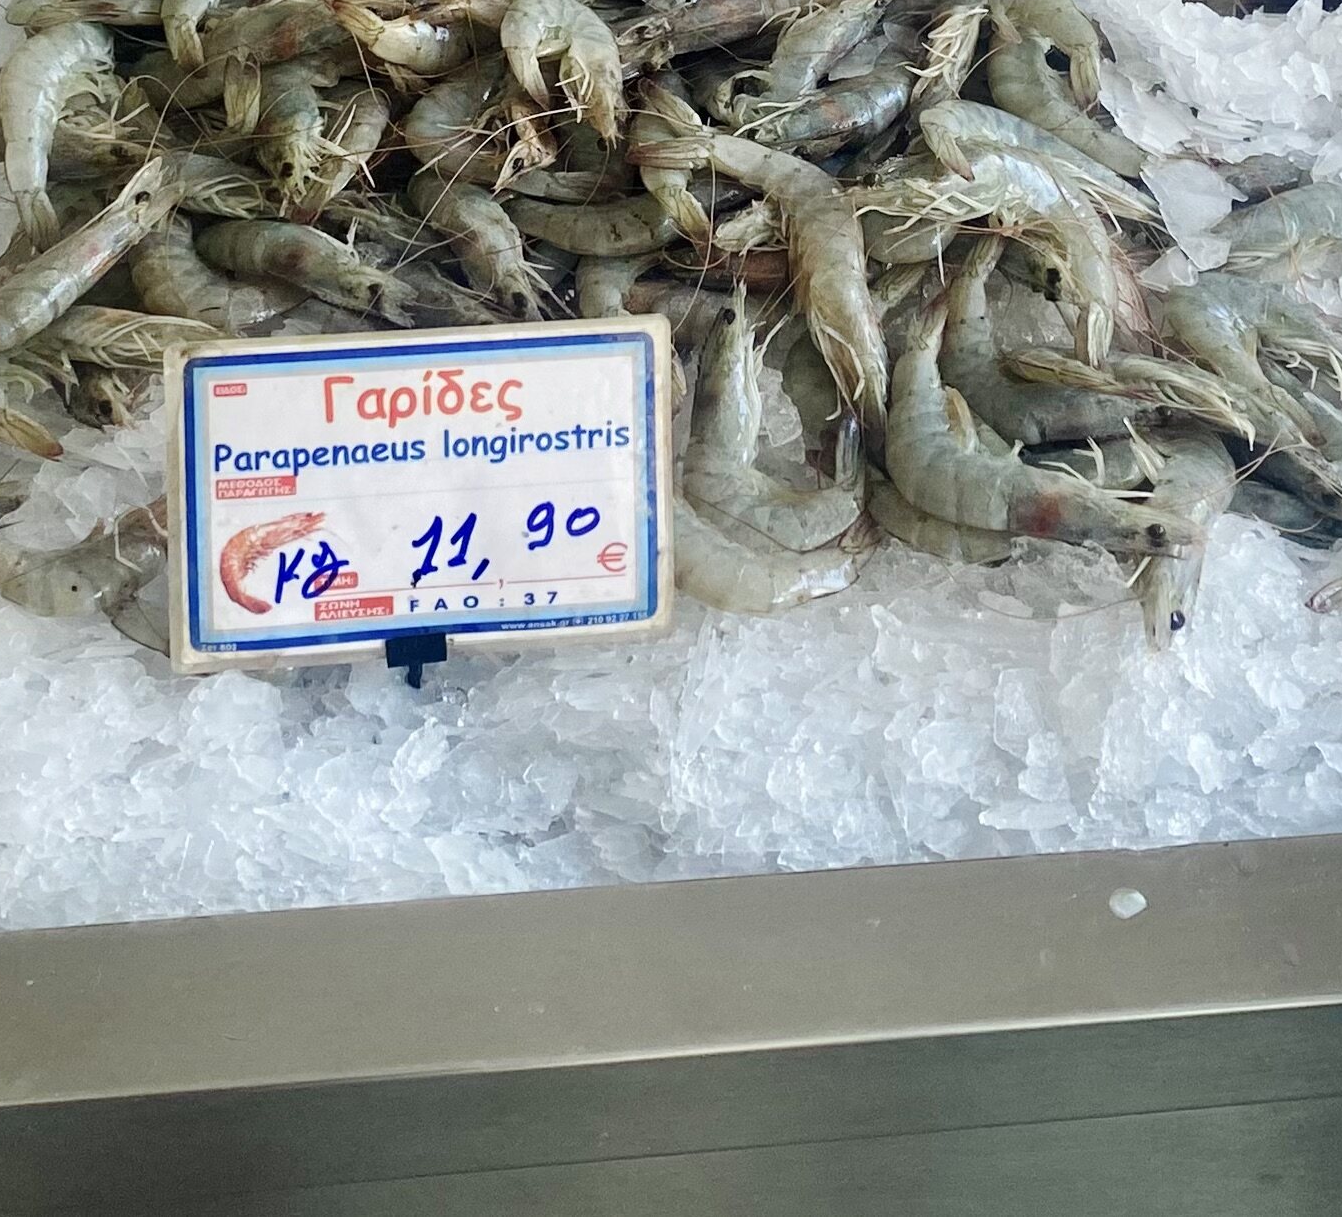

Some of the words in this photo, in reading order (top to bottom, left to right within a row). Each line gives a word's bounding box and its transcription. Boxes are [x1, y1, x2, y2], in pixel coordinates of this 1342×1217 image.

[322, 368, 524, 428] Γαρίδες
[214, 437, 426, 477] Parapenaeus
[443, 420, 631, 465] longirostris
[319, 600, 361, 611] ΖΩΝΗ
[409, 595, 480, 613] FAO
[523, 591, 559, 606] 37
